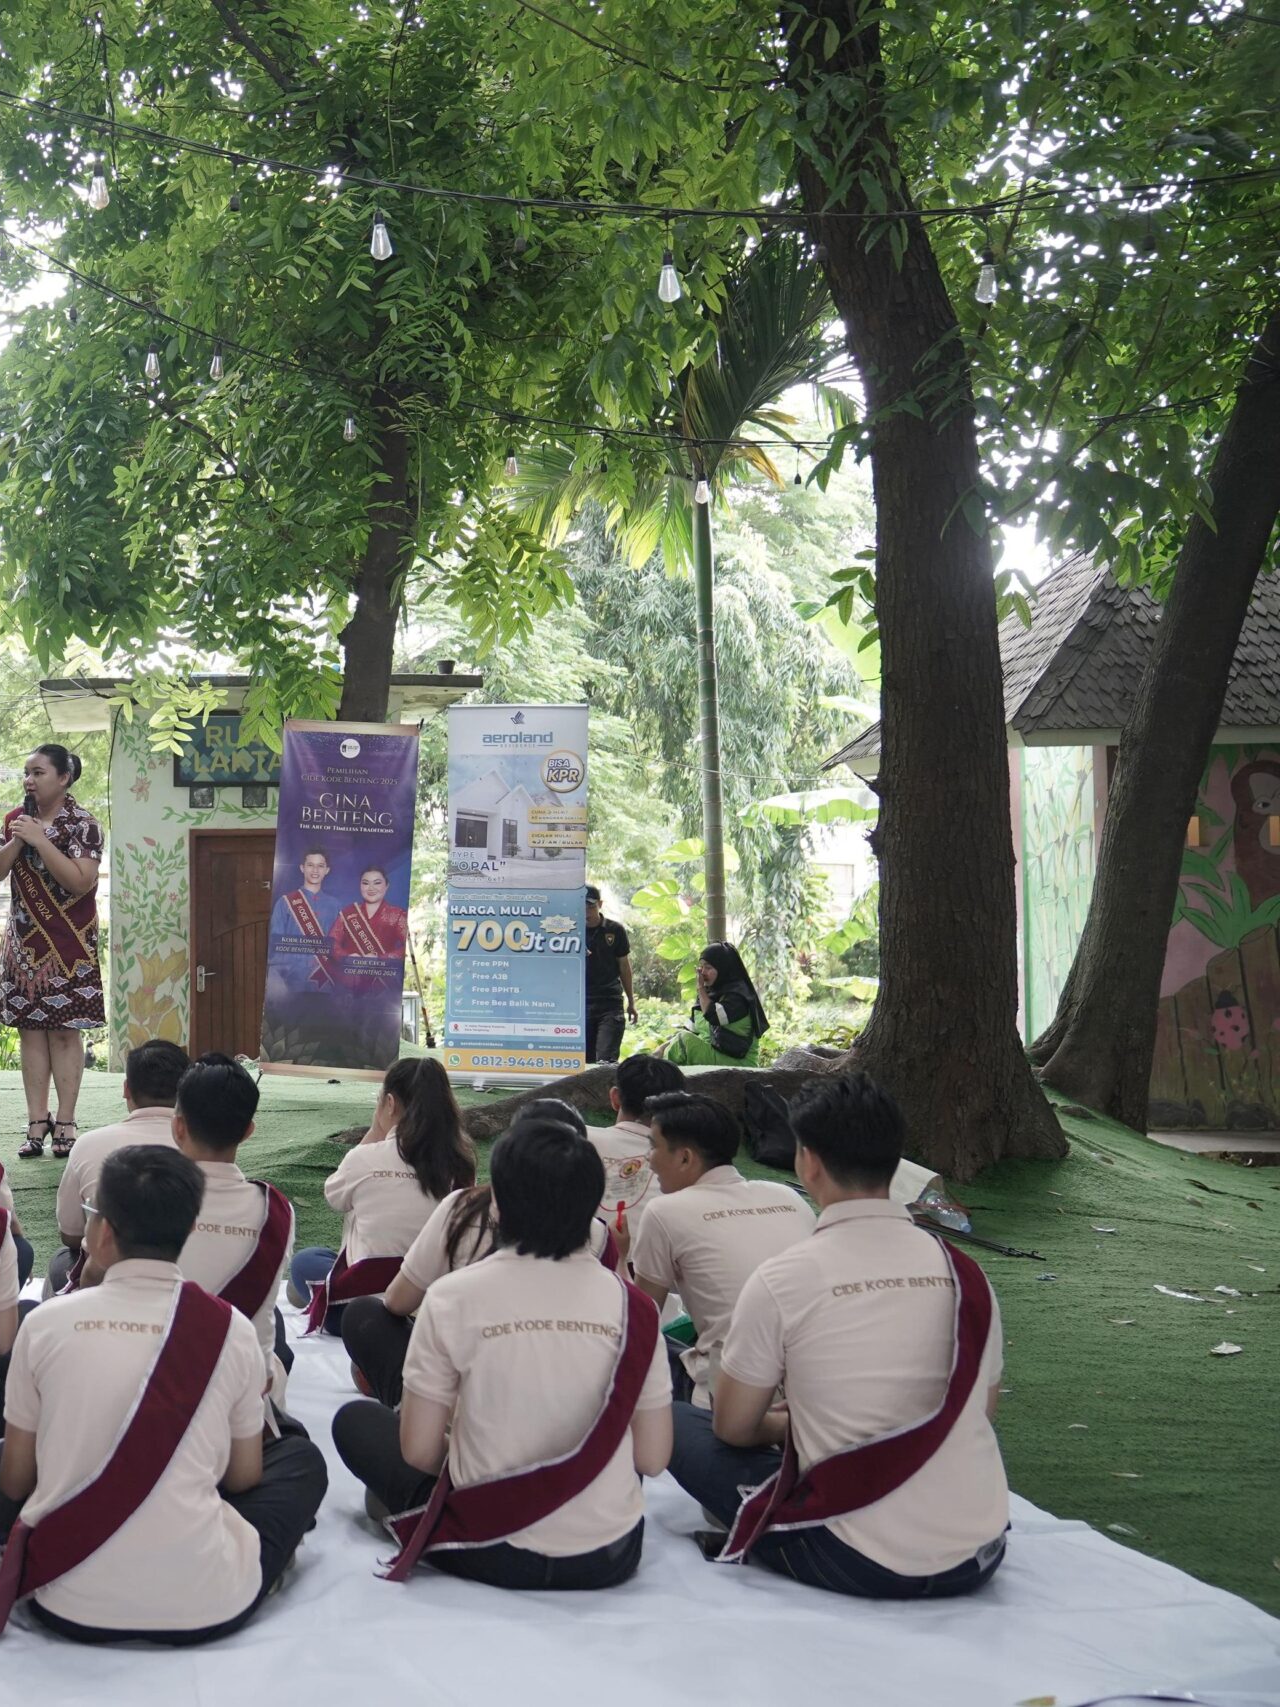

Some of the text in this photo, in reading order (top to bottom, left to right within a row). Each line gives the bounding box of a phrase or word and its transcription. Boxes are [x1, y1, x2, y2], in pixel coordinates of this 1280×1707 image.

[482, 732, 553, 743] aeroland
[548, 759, 570, 768] BISA
[327, 767, 368, 775] PEMILIHAN
[547, 768, 580, 782] KPR
[344, 776, 379, 784] BENTENG
[320, 792, 371, 810] CINA
[302, 806, 393, 826] BENTENG
[16, 862, 53, 920] ENTENG 2024
[450, 905, 542, 916] HARGA MULAI
[452, 920, 530, 951] 700
[492, 960, 510, 968] PPN
[472, 1056, 580, 1069] 0812-9448-1999
[373, 1170, 394, 1178] CIDE
[703, 1210, 727, 1221] CIDE
[728, 1208, 756, 1216] KODE
[197, 1223, 258, 1238] ODE BENTE
[832, 1276, 955, 1297] CIDE KODE BENTE
[74, 1320, 105, 1332] CIDE
[108, 1320, 148, 1333] KODE
[482, 1320, 618, 1339] CIDE KODE BENTENG
